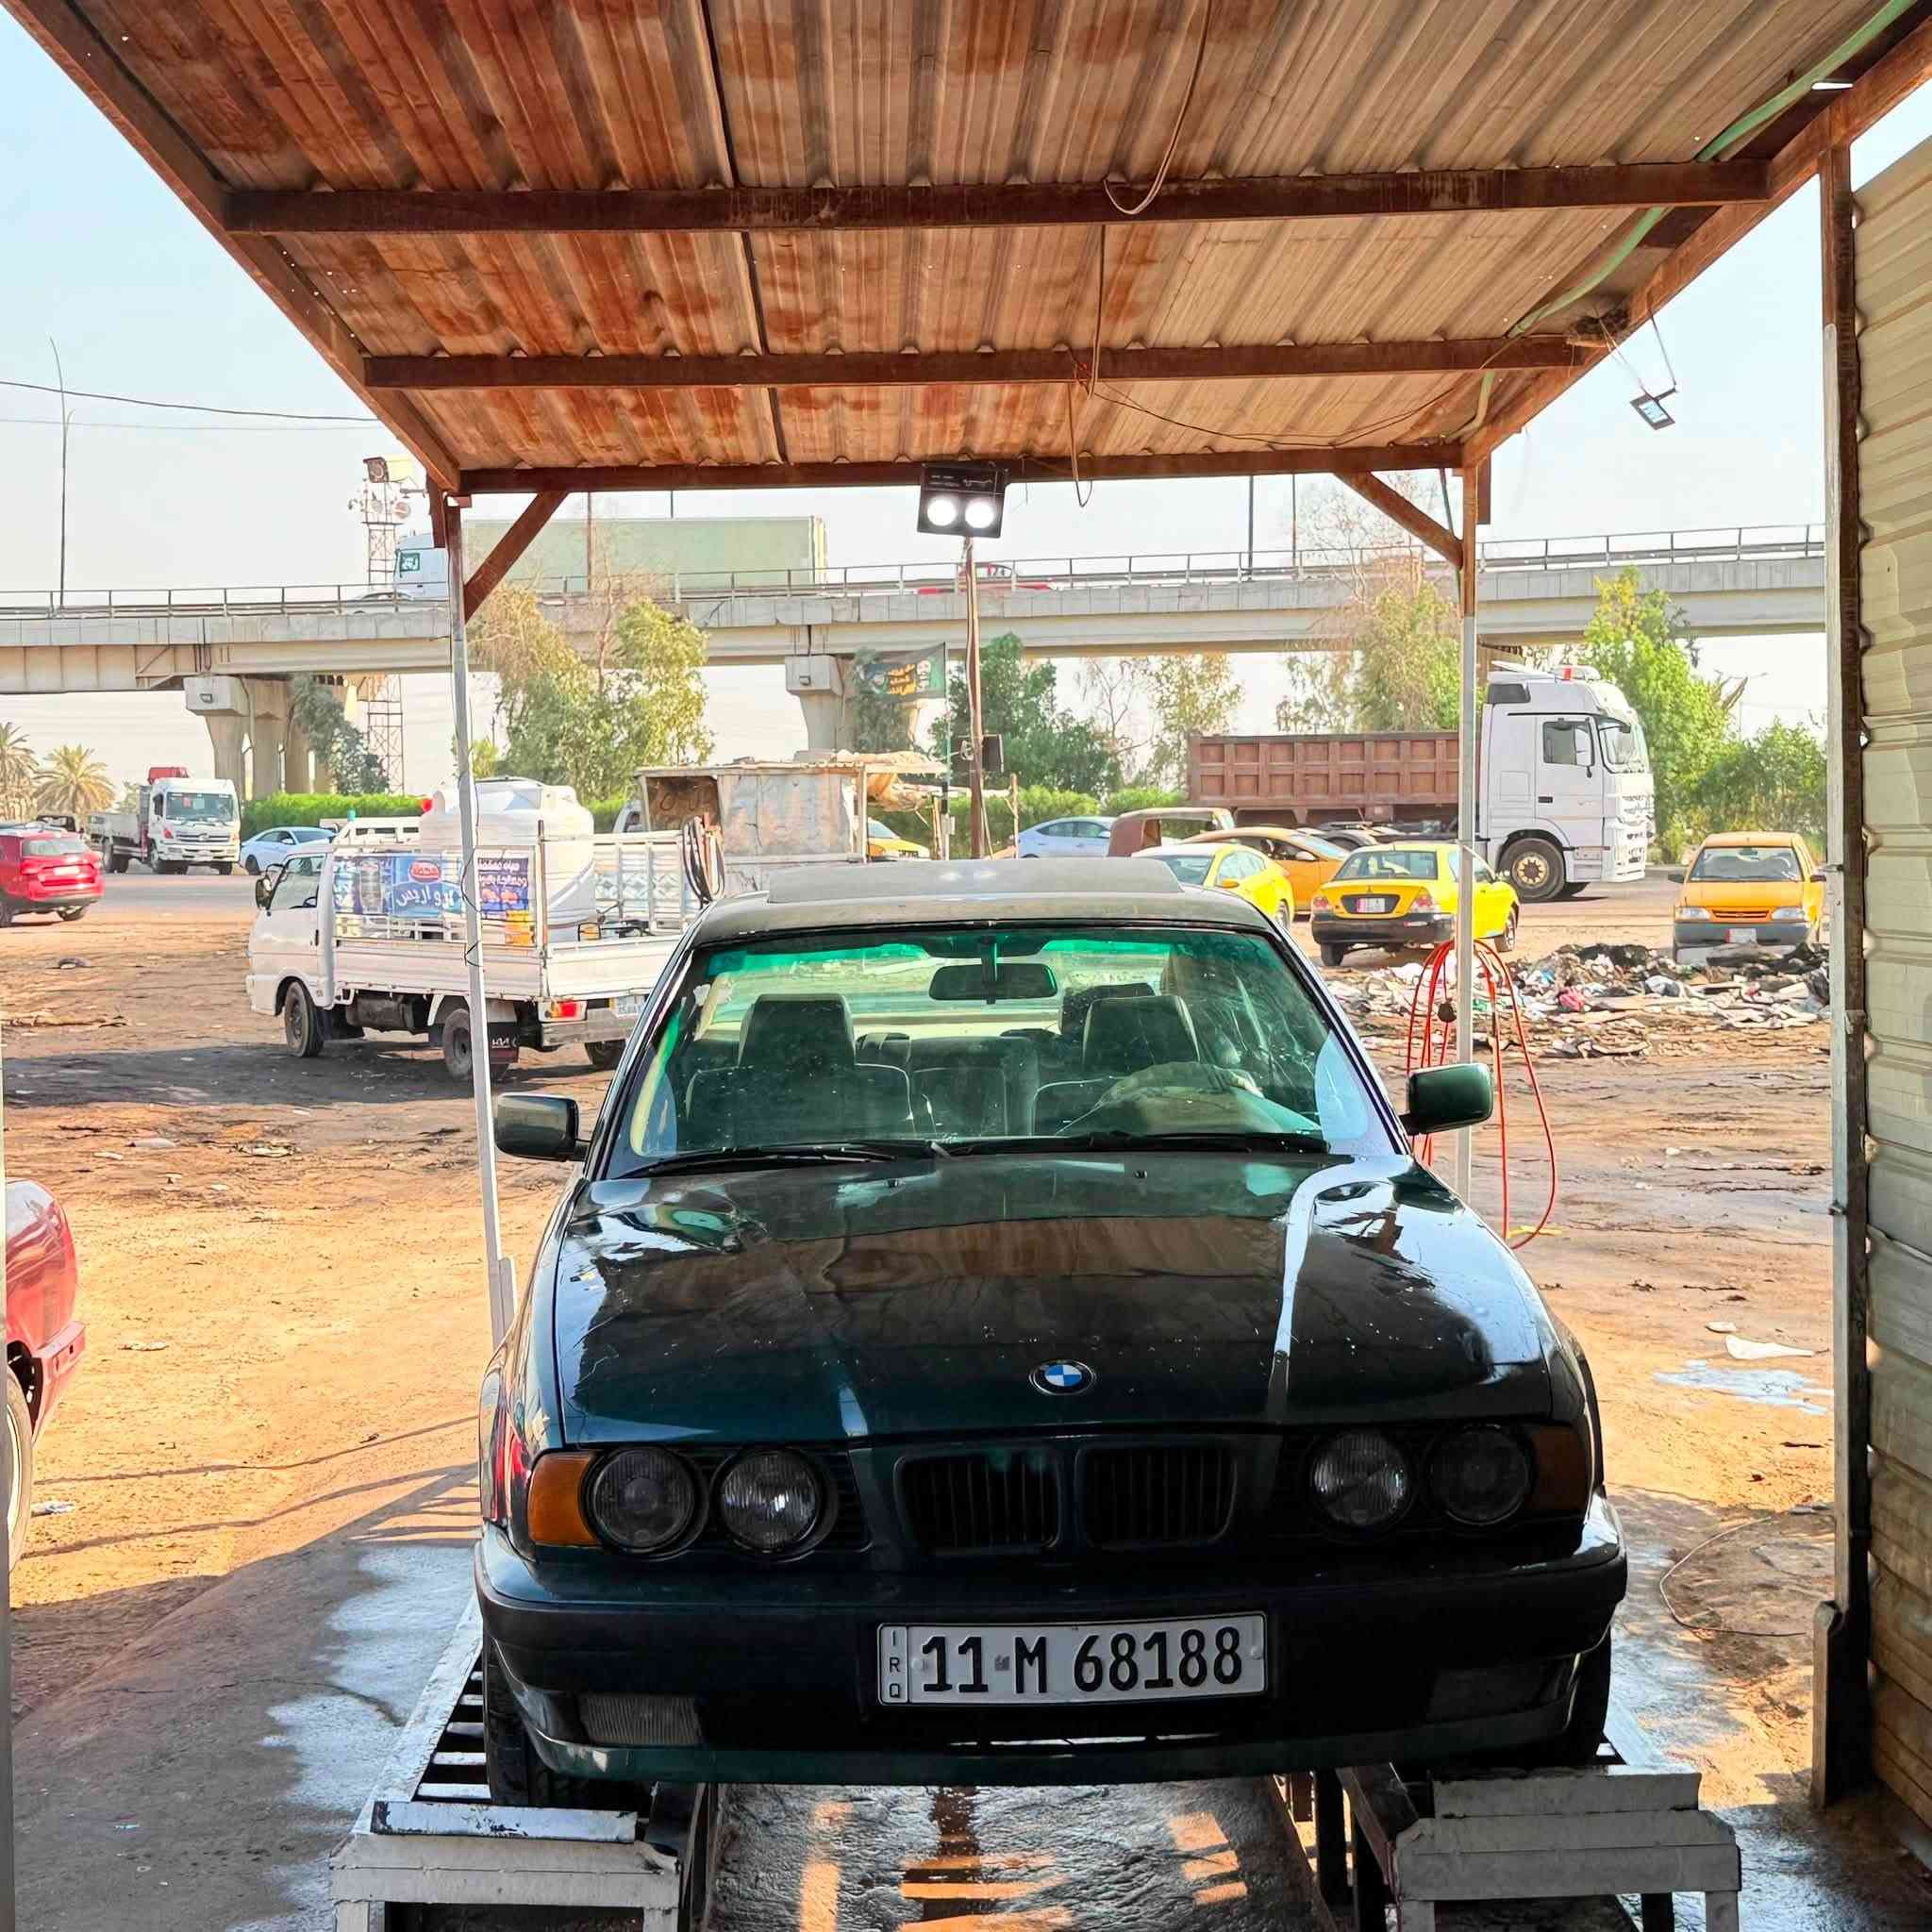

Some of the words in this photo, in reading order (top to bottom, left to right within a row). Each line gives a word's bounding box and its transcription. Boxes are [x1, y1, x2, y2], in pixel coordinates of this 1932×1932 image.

[889, 1630, 900, 1698] IRQ
[922, 1636, 989, 1692] 11
[1014, 1636, 1047, 1693] M
[1074, 1626, 1242, 1692] 68188
